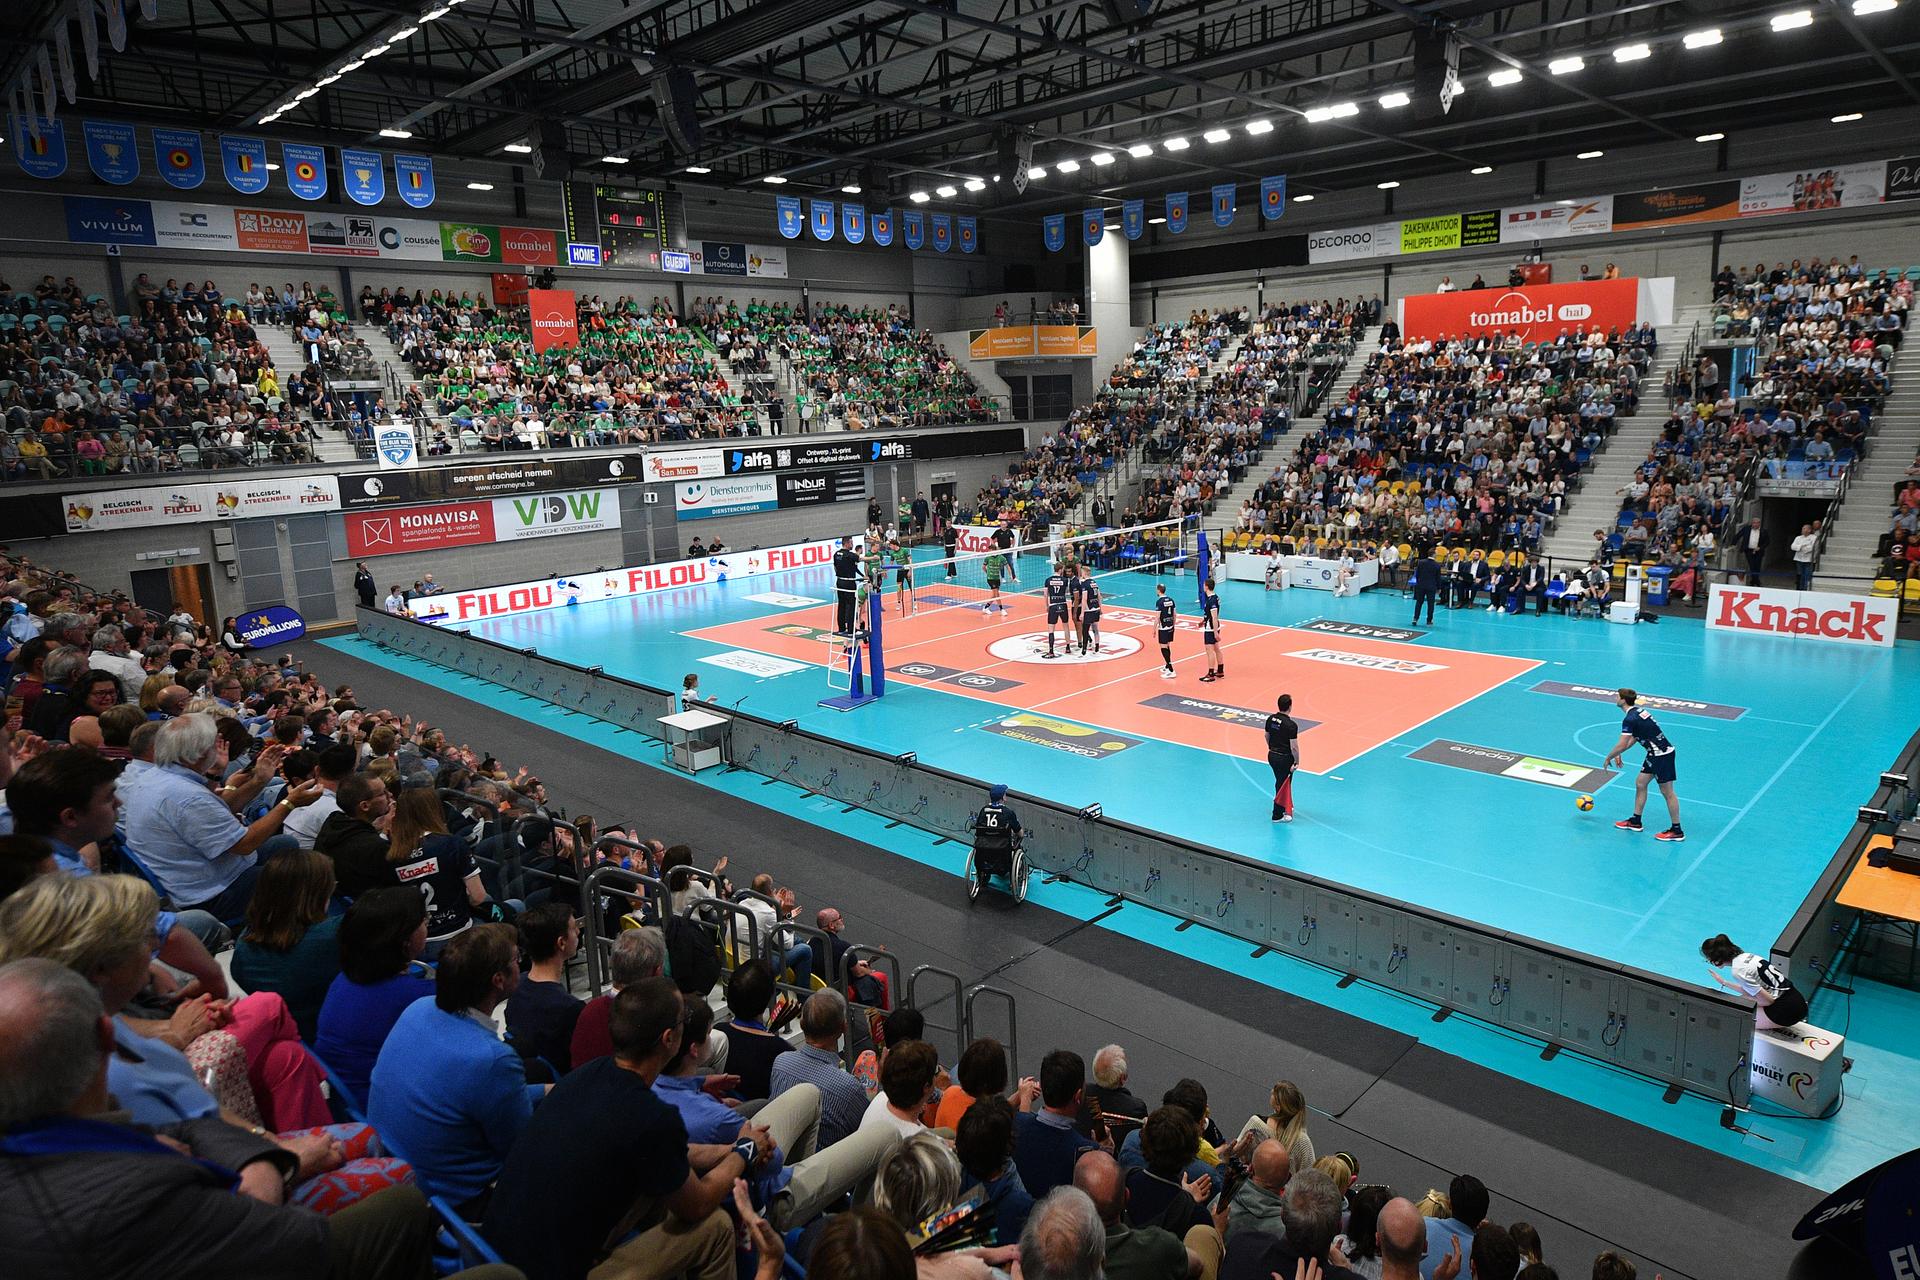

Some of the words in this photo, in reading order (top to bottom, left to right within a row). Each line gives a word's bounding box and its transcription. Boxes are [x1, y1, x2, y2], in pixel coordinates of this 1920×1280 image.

[596, 187, 603, 197] H
[648, 193, 654, 202] G
[81, 220, 143, 232] VIVIUM
[260, 215, 303, 234] Dovy
[261, 227, 296, 235] KEUKENS
[1404, 218, 1459, 235] ZAKENKANTOOR
[349, 236, 374, 246] DELHAIZE
[404, 236, 440, 245] coussée
[506, 240, 552, 251] tomabel
[1310, 232, 1372, 250] DECOROO
[1404, 237, 1432, 250] PHILIPPE
[1434, 234, 1457, 247] DHONT
[109, 245, 118, 254] 4
[573, 248, 596, 262] HOME
[665, 255, 687, 270] GUEST
[705, 261, 746, 270] AUTOMOBILIA
[1470, 304, 1553, 327] tomabel
[1565, 306, 1584, 318] hal
[535, 319, 574, 328] tomabel
[881, 443, 905, 457] alfa
[743, 452, 772, 468] alfa
[797, 457, 813, 465] Offset
[453, 474, 485, 484] sereen
[487, 470, 523, 481] afscheid
[525, 469, 552, 478] nemen
[660, 468, 674, 477] San
[677, 467, 697, 475] Marco
[475, 481, 535, 492] www.commeyne.be
[710, 482, 773, 496] Dienstenaanhuis
[244, 495, 291, 504] STREKENBIER
[247, 490, 281, 498] BELGISCH
[100, 505, 153, 516] STREKENBIER
[103, 500, 142, 509] BELGISCH
[712, 505, 759, 515] DIENSTENCHEQUES
[400, 510, 479, 528] MONAVISA
[402, 527, 446, 538] spanplafonds
[453, 523, 480, 531] -wanden
[515, 527, 559, 537] VANDENWEGHE
[559, 523, 605, 533] VERZEKERINGEN
[956, 526, 998, 553] Kna
[768, 544, 832, 572] FILOU
[628, 563, 706, 593] FILOU
[456, 585, 552, 620] FILOU
[1715, 590, 1886, 642] Knack
[242, 619, 302, 640] EUROMILLIONS
[1312, 623, 1410, 639] SAMYN
[1302, 650, 1382, 667] Dovy
[1450, 746, 1515, 762] lapeire
[985, 814, 998, 828] 16
[398, 861, 437, 881] Knack
[420, 881, 438, 912] 2
[1752, 1063, 1784, 1082] VOLLEY
